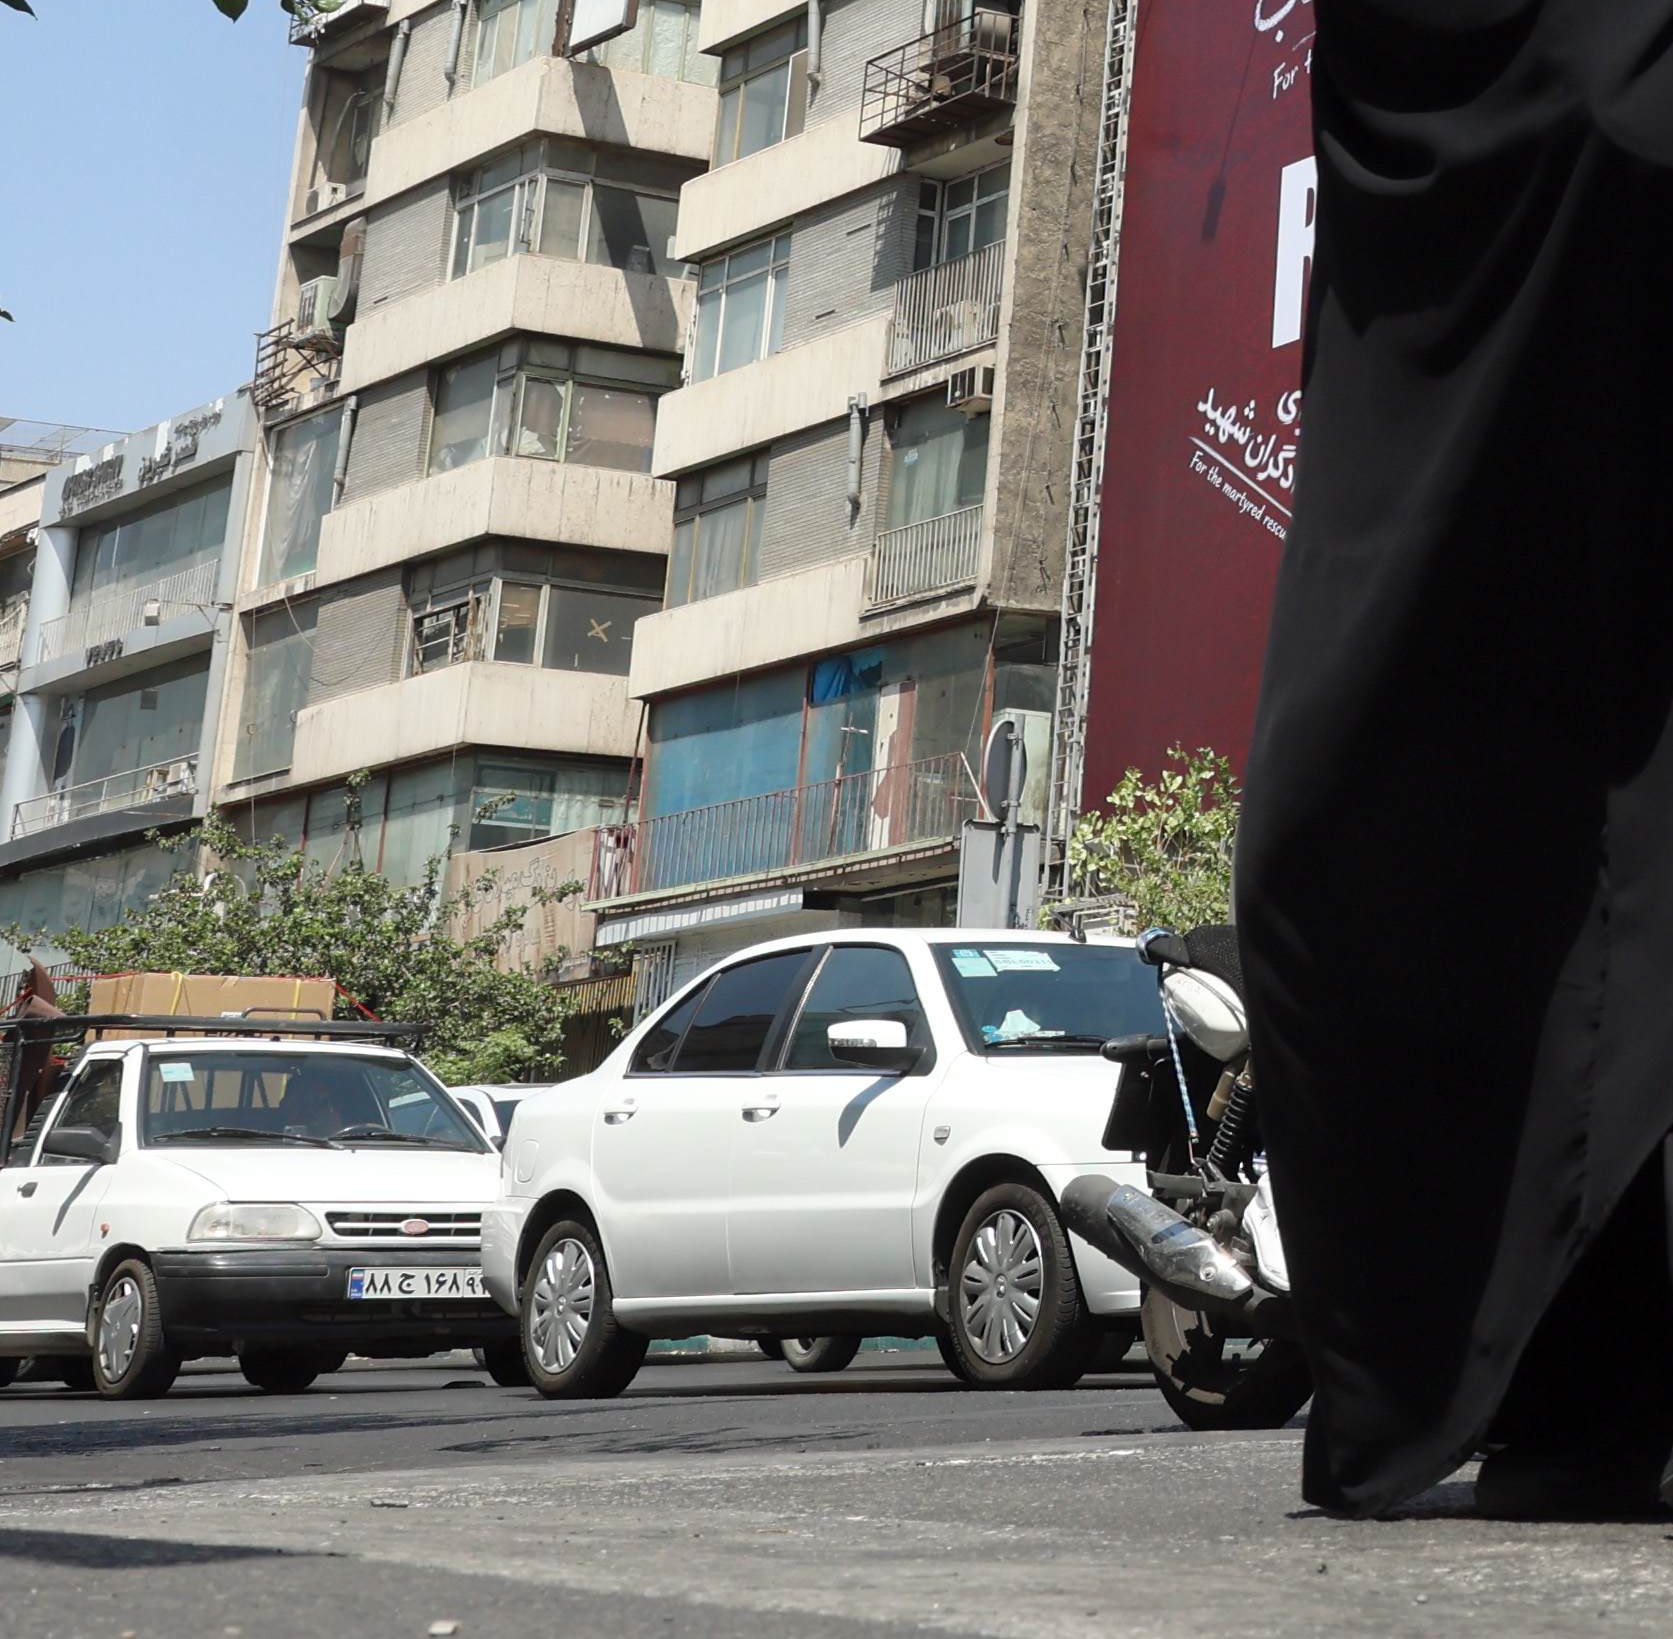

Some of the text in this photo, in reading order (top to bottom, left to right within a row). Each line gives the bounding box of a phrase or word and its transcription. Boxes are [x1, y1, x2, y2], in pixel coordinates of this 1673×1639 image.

[1273, 62, 1299, 100] For
[1197, 387, 1256, 445] شهید
[1189, 451, 1286, 539] For the martyred rescu
